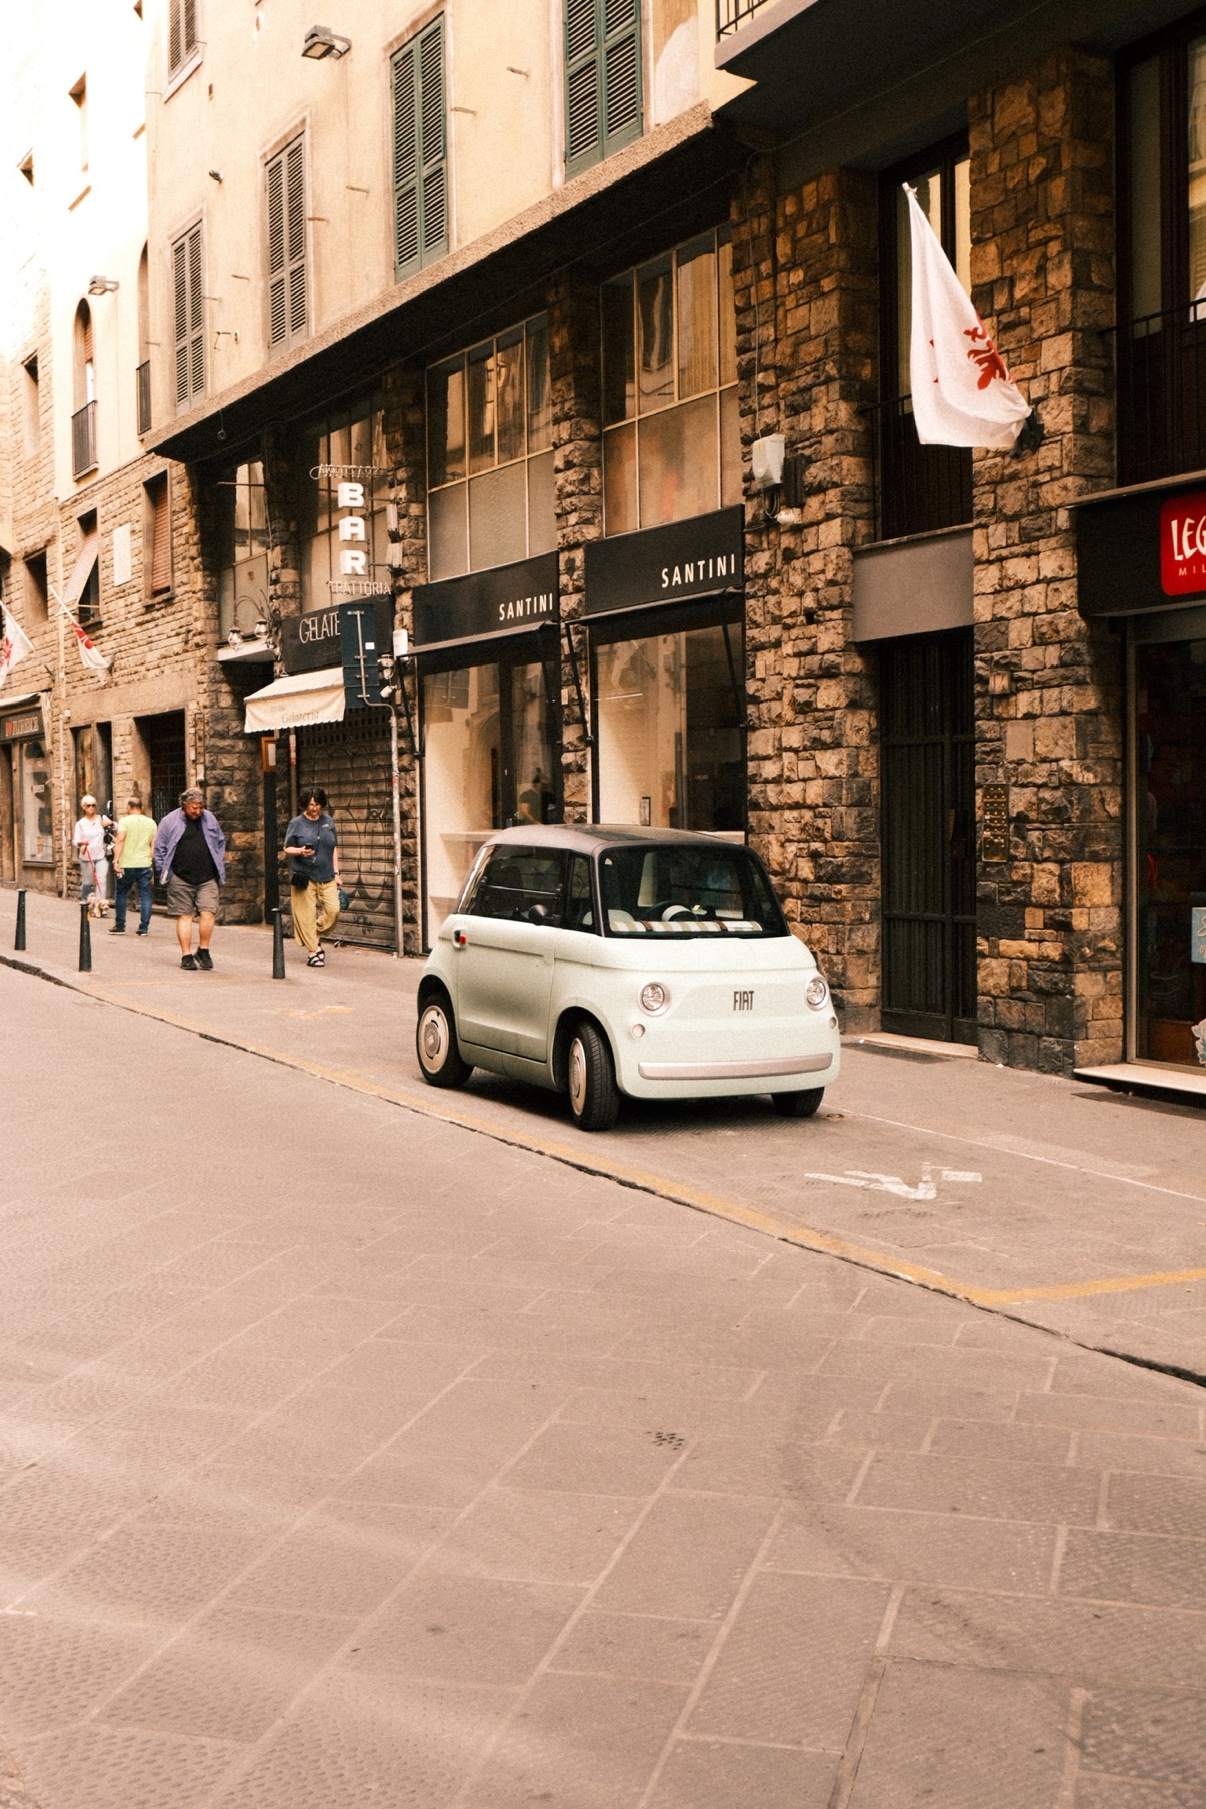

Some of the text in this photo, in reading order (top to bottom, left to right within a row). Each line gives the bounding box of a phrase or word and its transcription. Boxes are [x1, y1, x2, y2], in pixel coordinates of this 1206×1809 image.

[337, 482, 366, 575] BAR
[661, 553, 736, 588] SANTINI
[328, 580, 392, 596] TRATTORIA
[498, 592, 553, 621] SANTINI
[299, 611, 341, 644] GELATE
[733, 990, 754, 1011] FIAT
